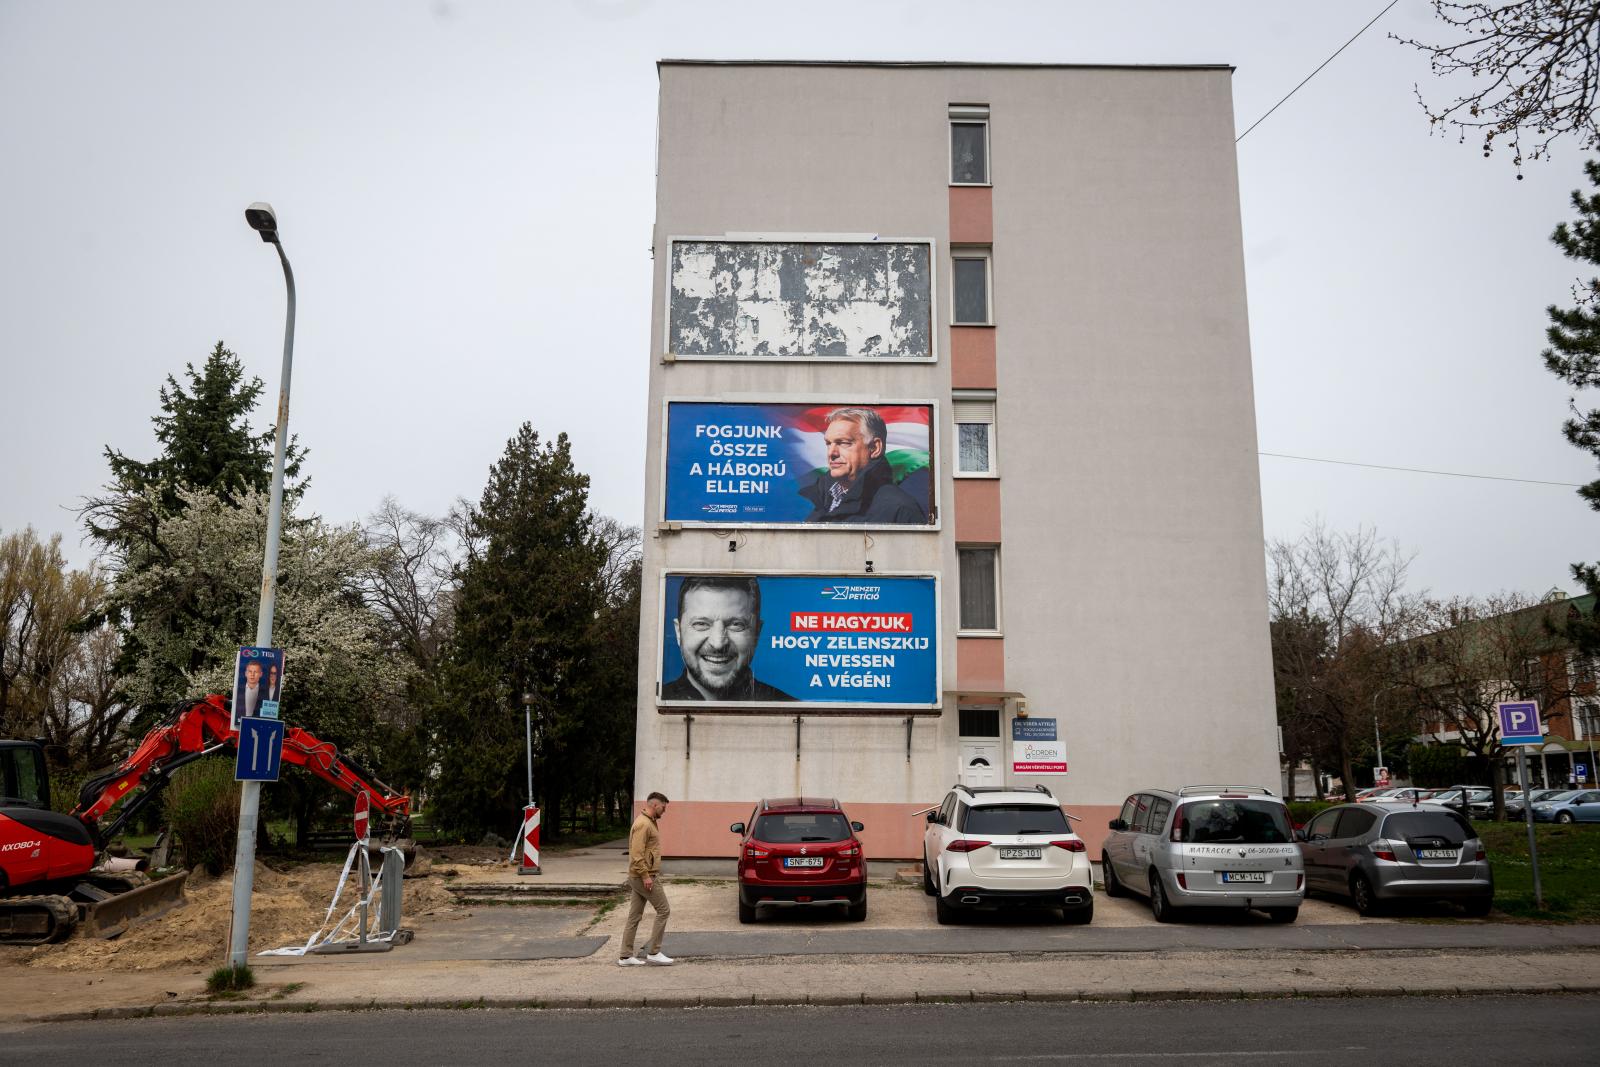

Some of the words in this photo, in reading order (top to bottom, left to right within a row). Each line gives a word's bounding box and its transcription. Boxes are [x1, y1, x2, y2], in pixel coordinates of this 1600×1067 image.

[695, 424, 783, 439] FOGJUNK
[709, 440, 768, 457] ÖSSZE
[689, 462, 703, 476] A
[708, 459, 786, 477] HÁBORÚ
[706, 480, 769, 494] ELLEN!
[848, 592, 880, 600] PETÍCIÓ
[795, 615, 818, 628] NE
[823, 615, 910, 631] HAGYJUK,
[771, 636, 822, 649] HOGY
[826, 636, 929, 650] ZELENSZKIJ
[805, 654, 895, 668] NEVESSEN
[809, 674, 822, 687] A
[828, 671, 891, 688] VÉGÉN!
[1510, 711, 1526, 730] P
[1576, 765, 1584, 775] P
[2, 841, 41, 852] KX080-4
[1006, 849, 1040, 857] PZS-101
[789, 858, 822, 866] SNF-675
[1228, 872, 1263, 881] MCM-144
